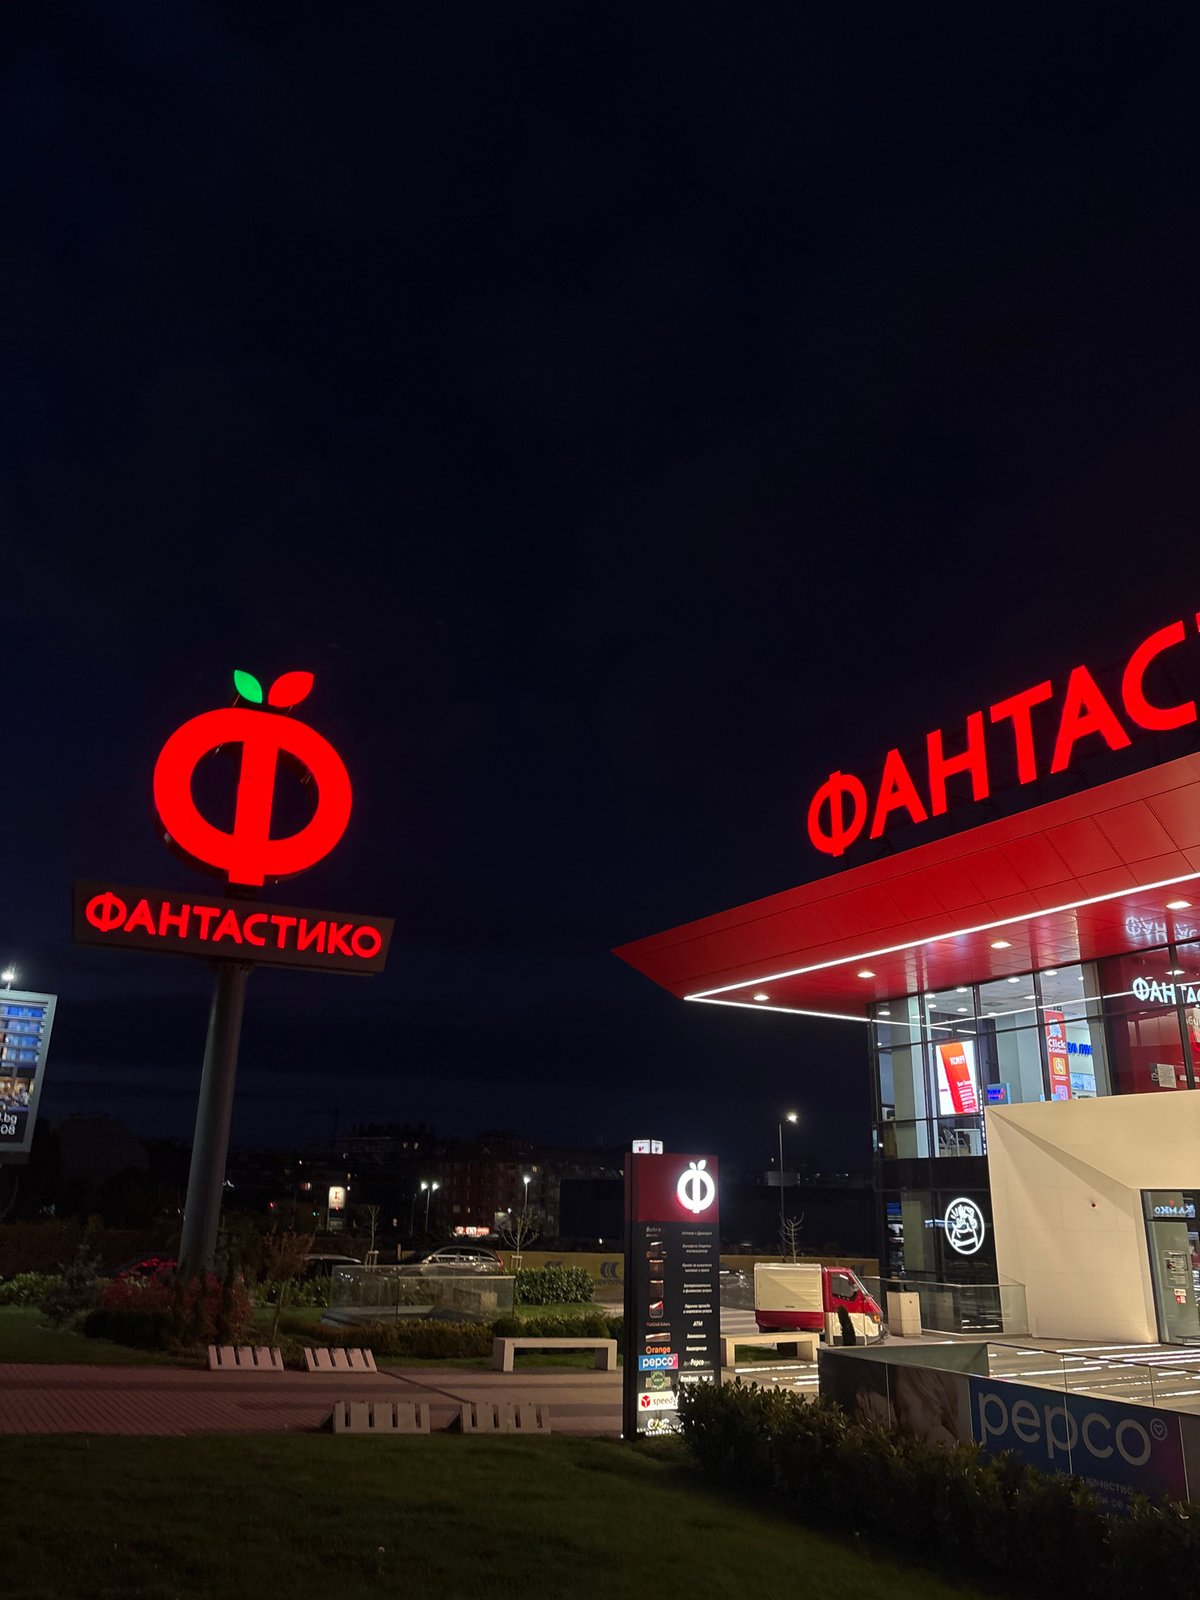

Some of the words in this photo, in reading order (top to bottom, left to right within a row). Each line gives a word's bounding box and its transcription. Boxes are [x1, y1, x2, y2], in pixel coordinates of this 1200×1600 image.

[807, 612, 1200, 857] ФАНТАС
[85, 892, 382, 959] ФАНТАСТИКО
[642, 1357, 674, 1368] pepco
[645, 1345, 671, 1354] Orange
[978, 1392, 1152, 1466] pepco
